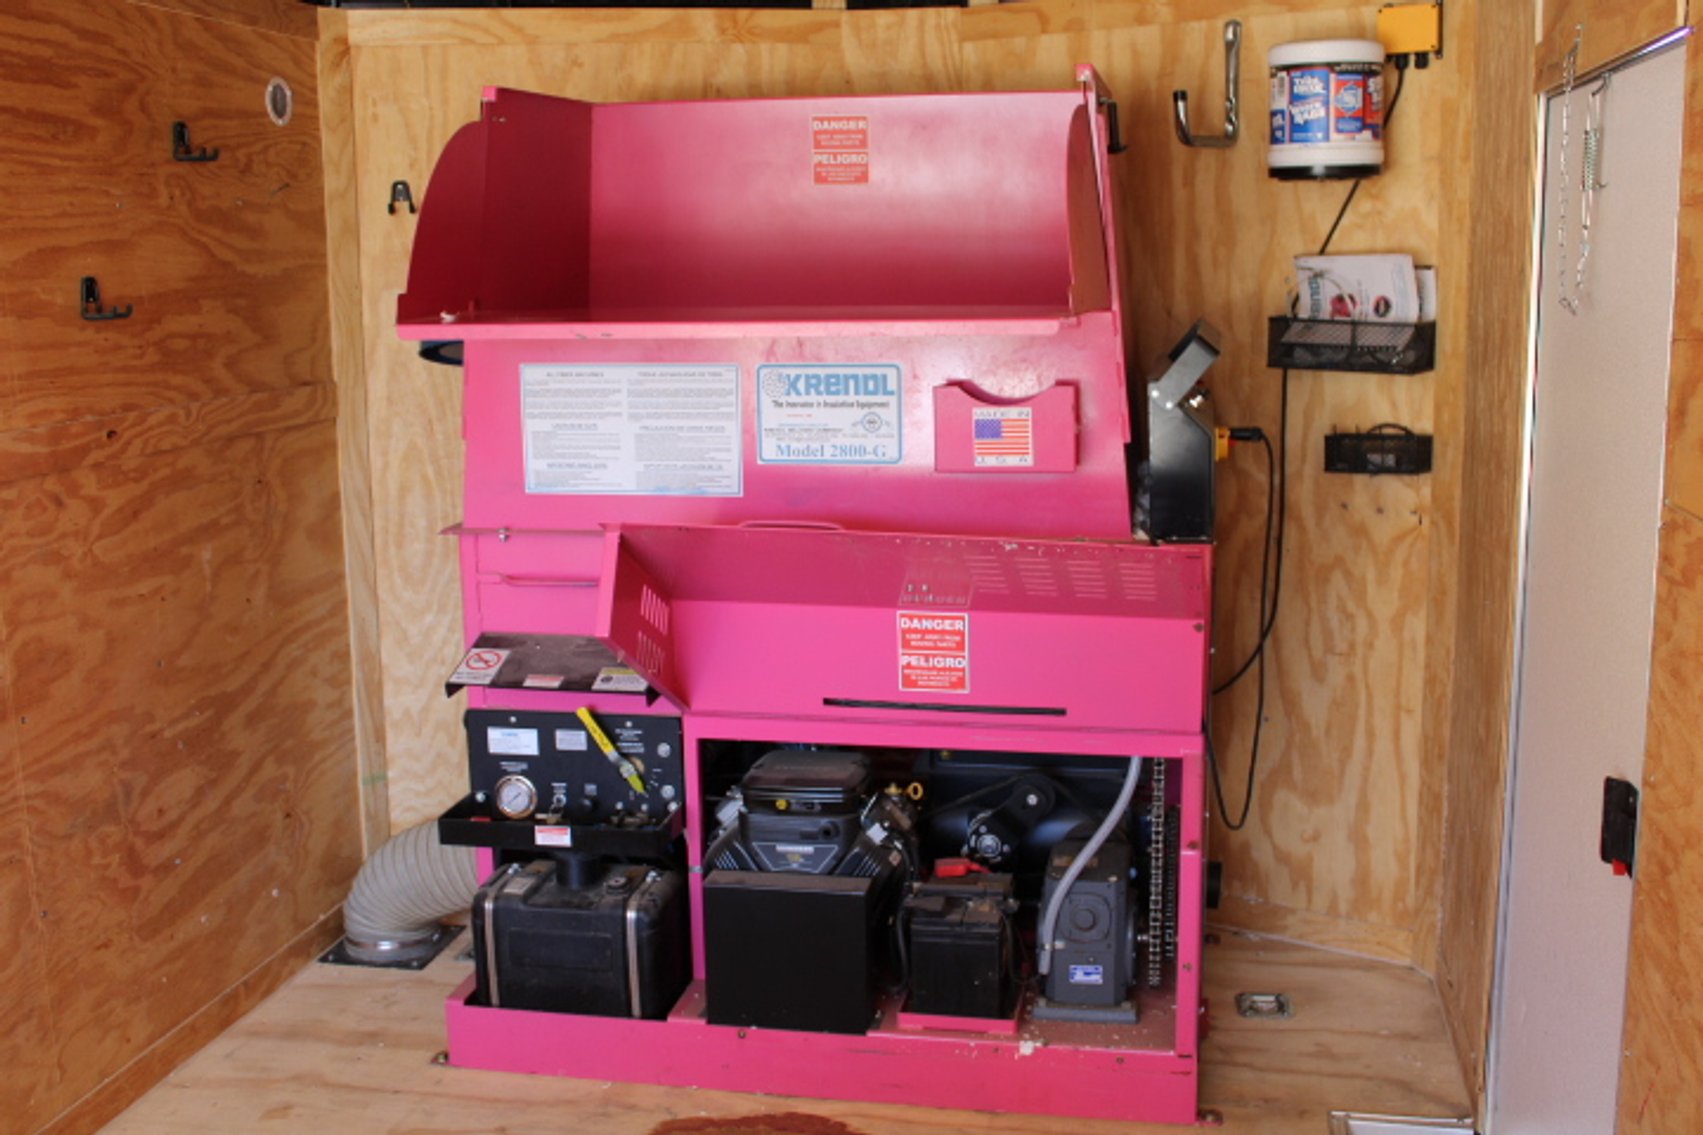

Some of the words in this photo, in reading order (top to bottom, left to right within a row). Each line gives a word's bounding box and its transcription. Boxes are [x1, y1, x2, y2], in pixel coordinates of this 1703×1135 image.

[812, 120, 868, 130] DANGER
[813, 153, 868, 164] PELIGRO
[775, 444, 825, 458] Model
[829, 444, 887, 458] 2800-G
[900, 617, 965, 631] DANGER
[901, 655, 967, 668] PELIGRO
